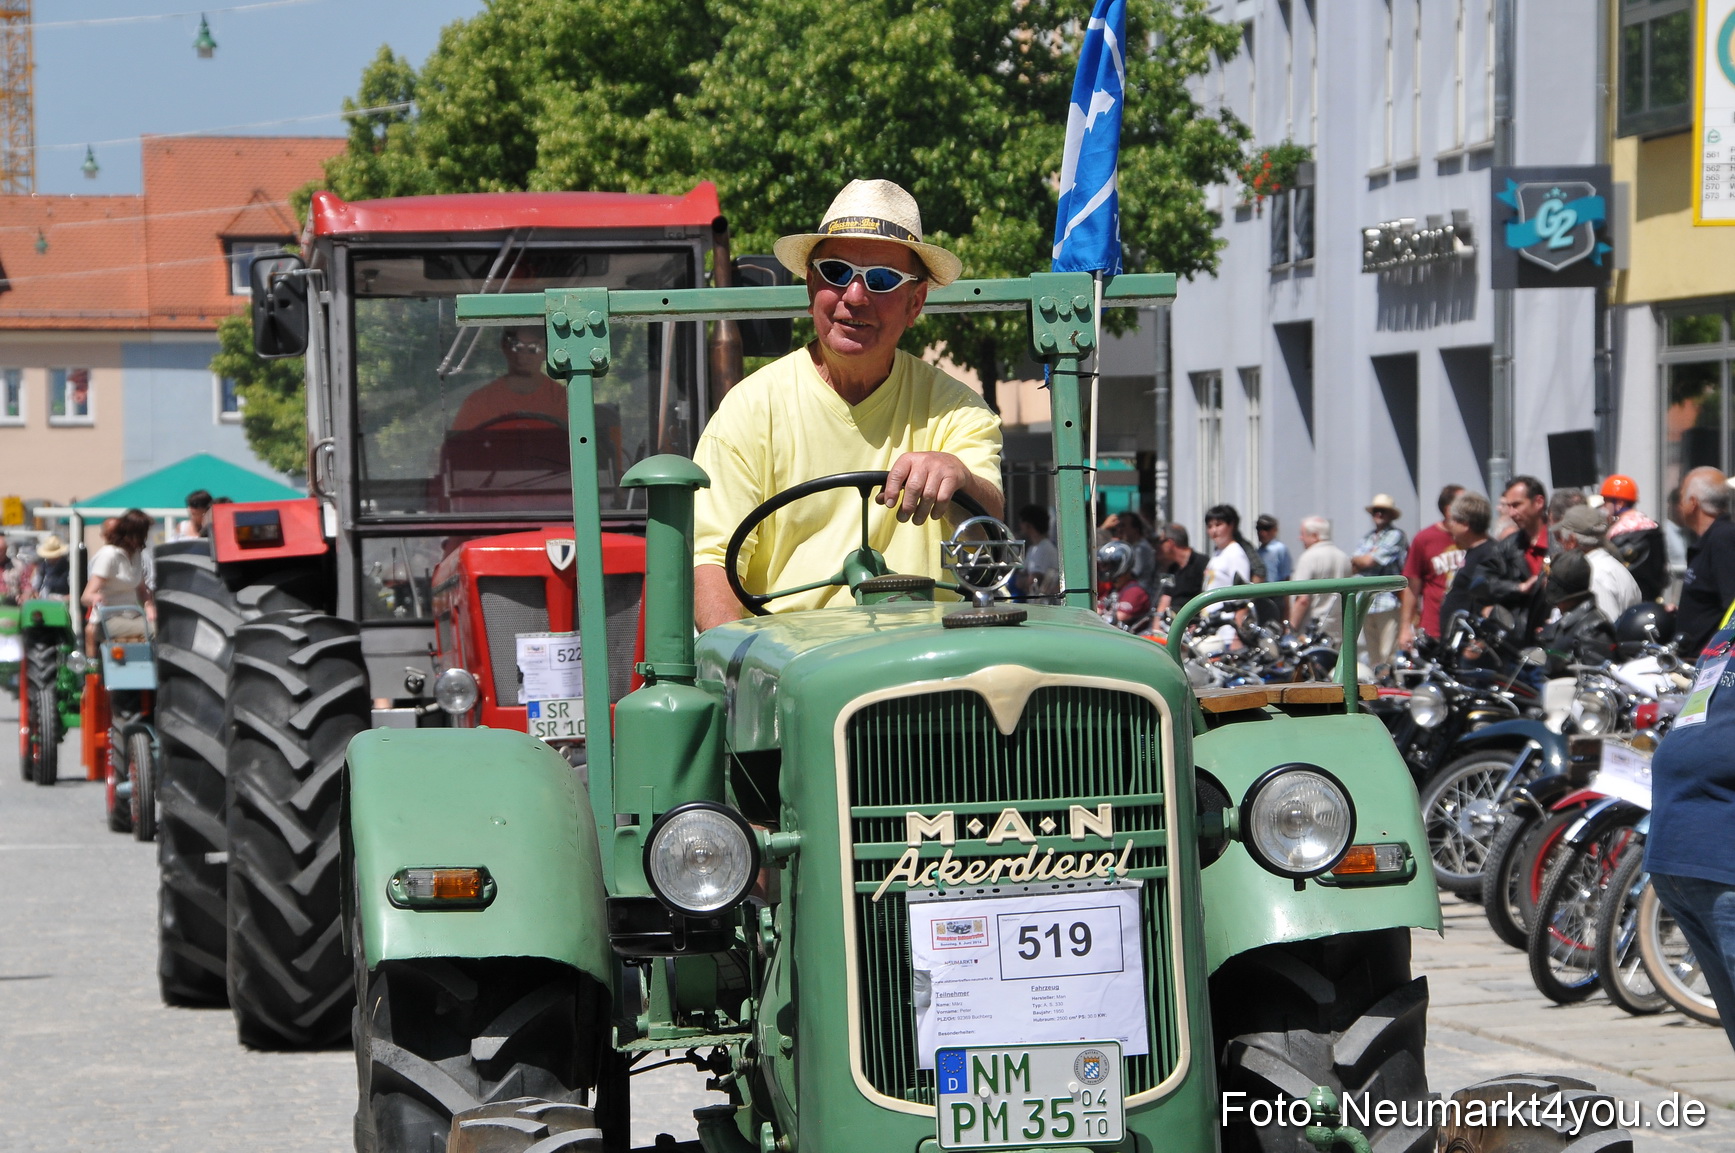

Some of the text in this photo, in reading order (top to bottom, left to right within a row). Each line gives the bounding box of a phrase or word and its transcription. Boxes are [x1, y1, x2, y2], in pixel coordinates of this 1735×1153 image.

[1705, 164, 1721, 172] 562
[1705, 182, 1720, 190] 570
[1705, 192, 1720, 200] 573
[1536, 198, 1578, 249] G2
[557, 646, 582, 663] 522
[547, 702, 570, 719] SR
[535, 721, 558, 738] SR
[872, 839, 1134, 902] Ackerdiesel
[1018, 921, 1092, 961] 519
[972, 1052, 1031, 1095] NM
[948, 1077, 959, 1091] D
[1081, 1089, 1107, 1107] 04
[950, 1097, 1076, 1143] PM 35
[1085, 1118, 1108, 1138] 10
